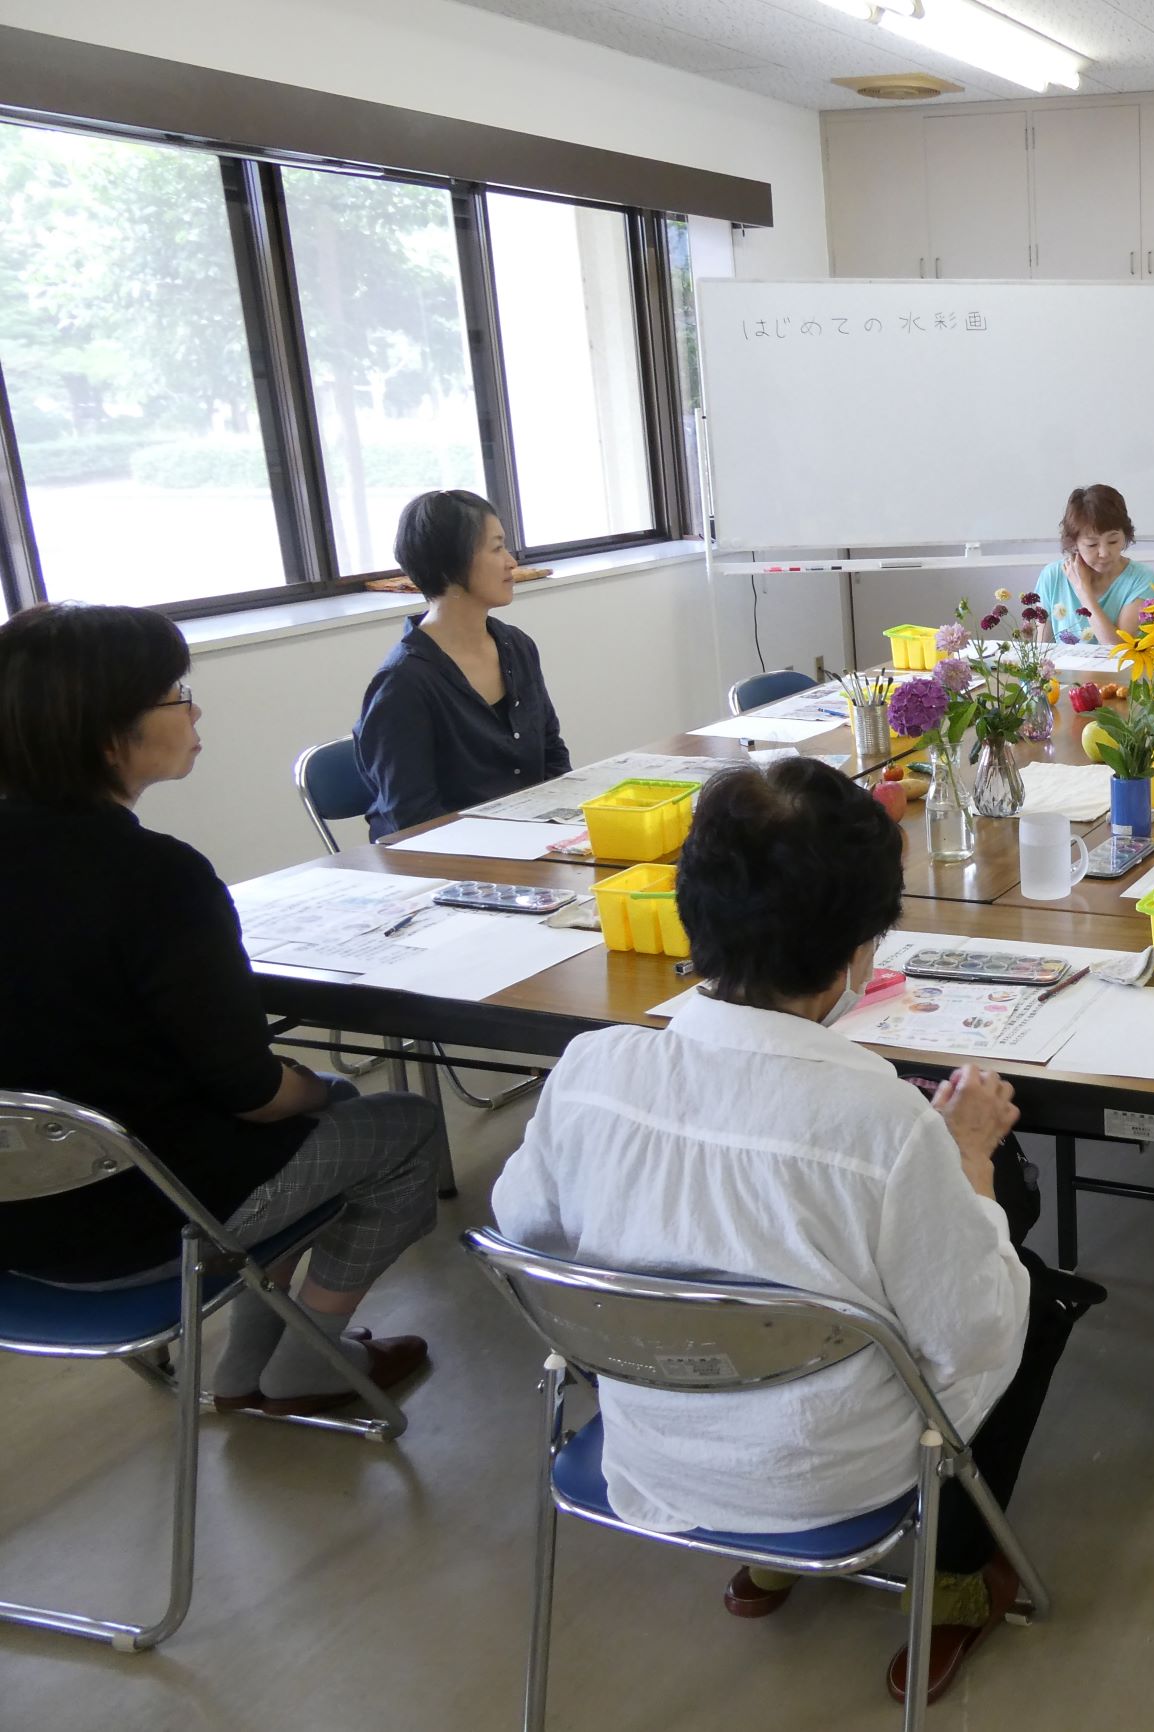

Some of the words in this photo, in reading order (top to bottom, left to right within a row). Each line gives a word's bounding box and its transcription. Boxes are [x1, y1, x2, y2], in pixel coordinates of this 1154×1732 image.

[742, 311, 988, 340] はじめての水彩画
